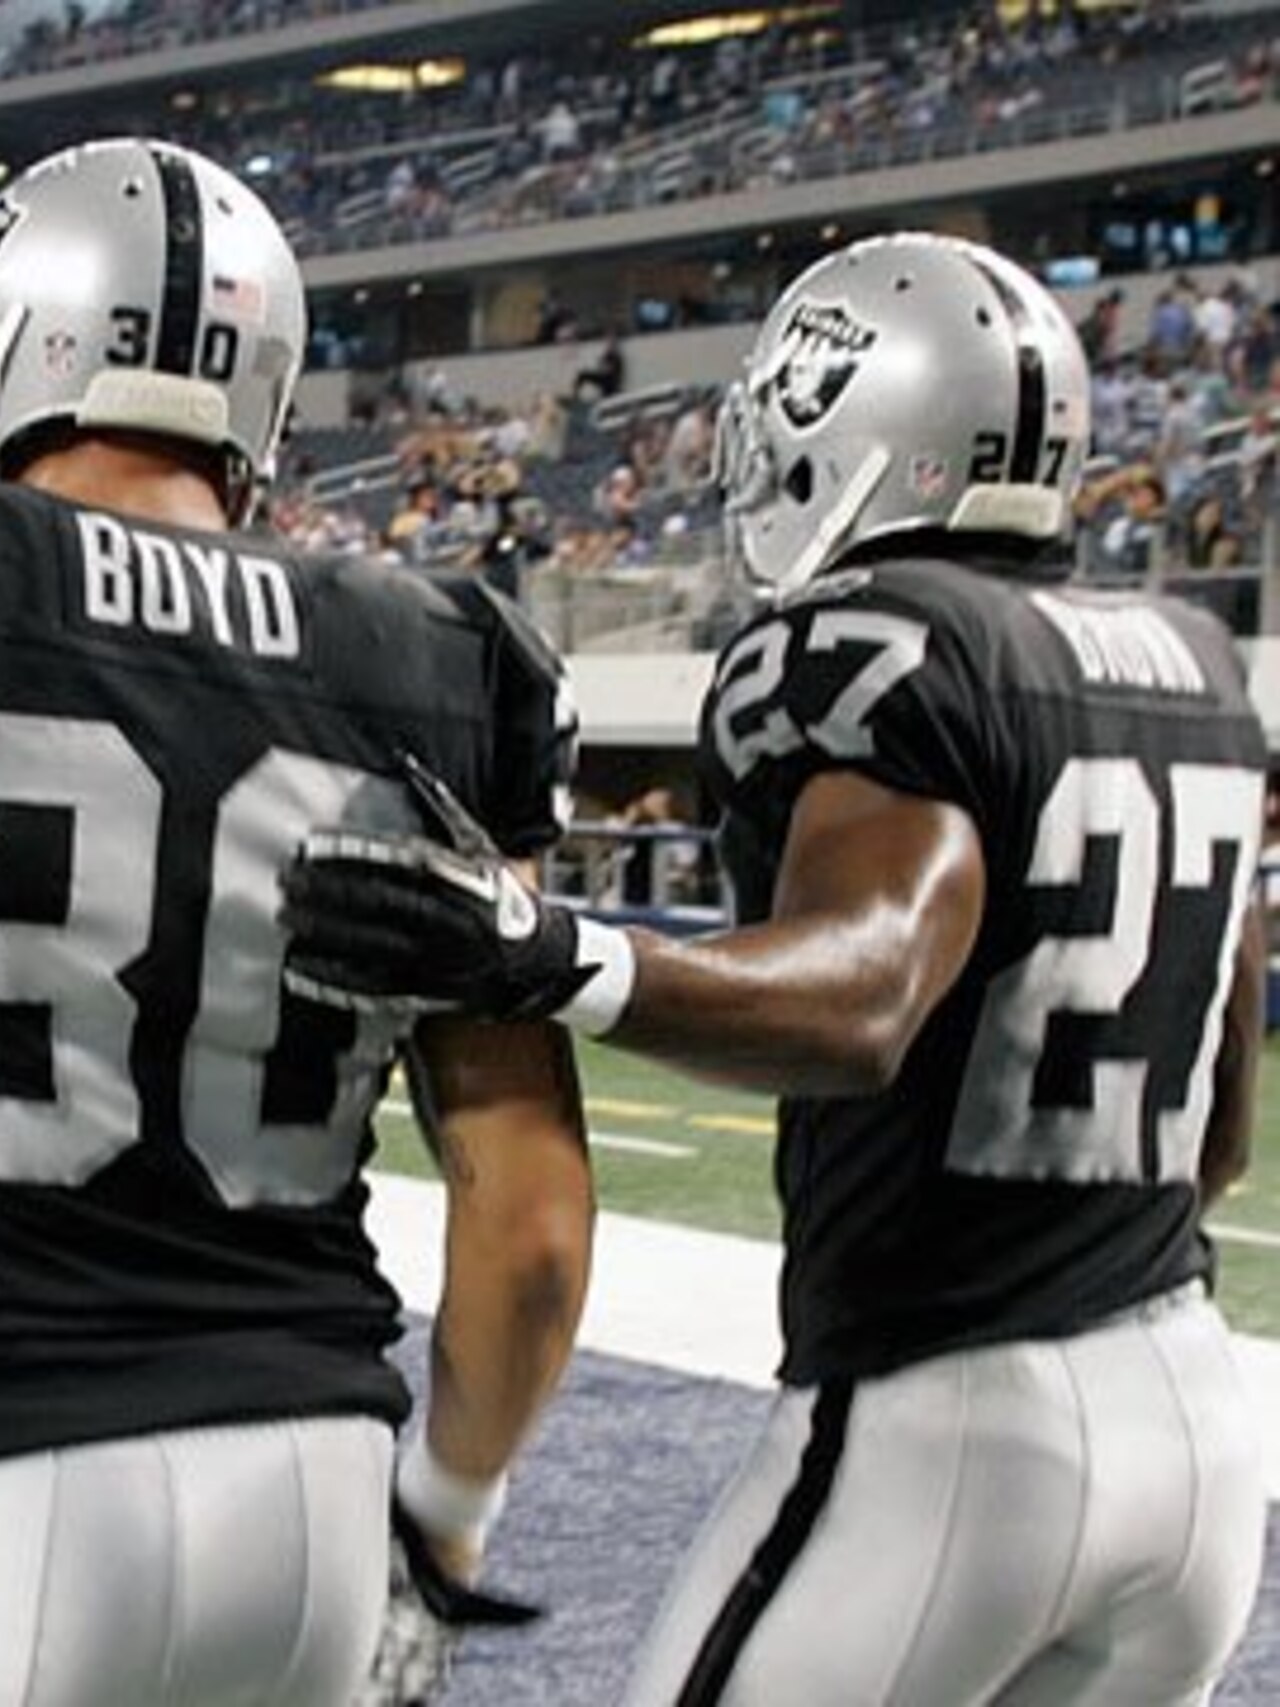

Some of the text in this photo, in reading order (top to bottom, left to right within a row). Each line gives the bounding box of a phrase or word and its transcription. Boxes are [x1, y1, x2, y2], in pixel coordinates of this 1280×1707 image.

[75, 511, 300, 658] BOYD
[713, 610, 929, 780] 27
[942, 757, 1266, 1184] 27
